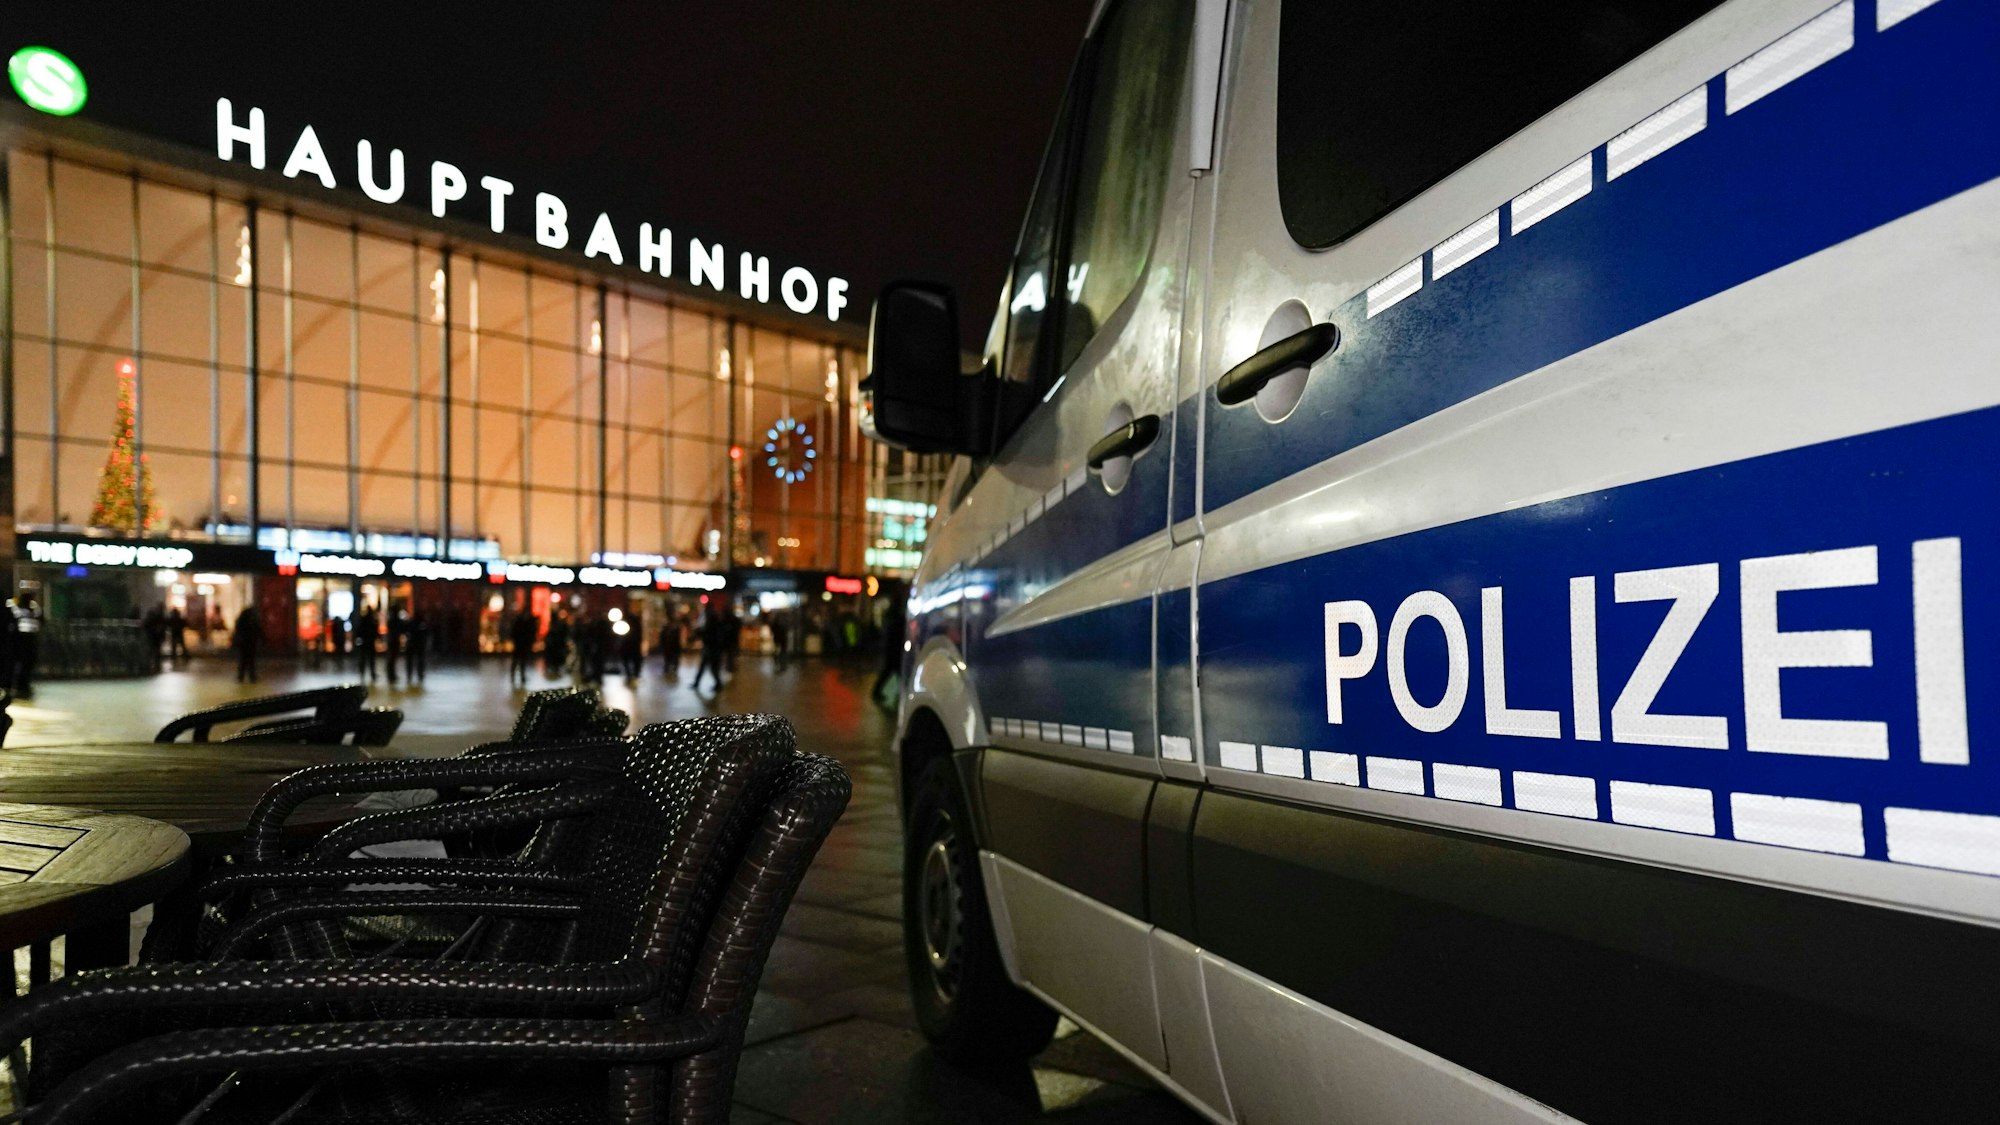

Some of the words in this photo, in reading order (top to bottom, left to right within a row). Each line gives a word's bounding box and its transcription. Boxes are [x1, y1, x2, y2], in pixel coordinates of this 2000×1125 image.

[21, 51, 76, 110] S
[216, 97, 849, 322] HAUPTBAHNHOF
[26, 540, 73, 563] THE
[1324, 537, 1970, 765] POLIZEI
